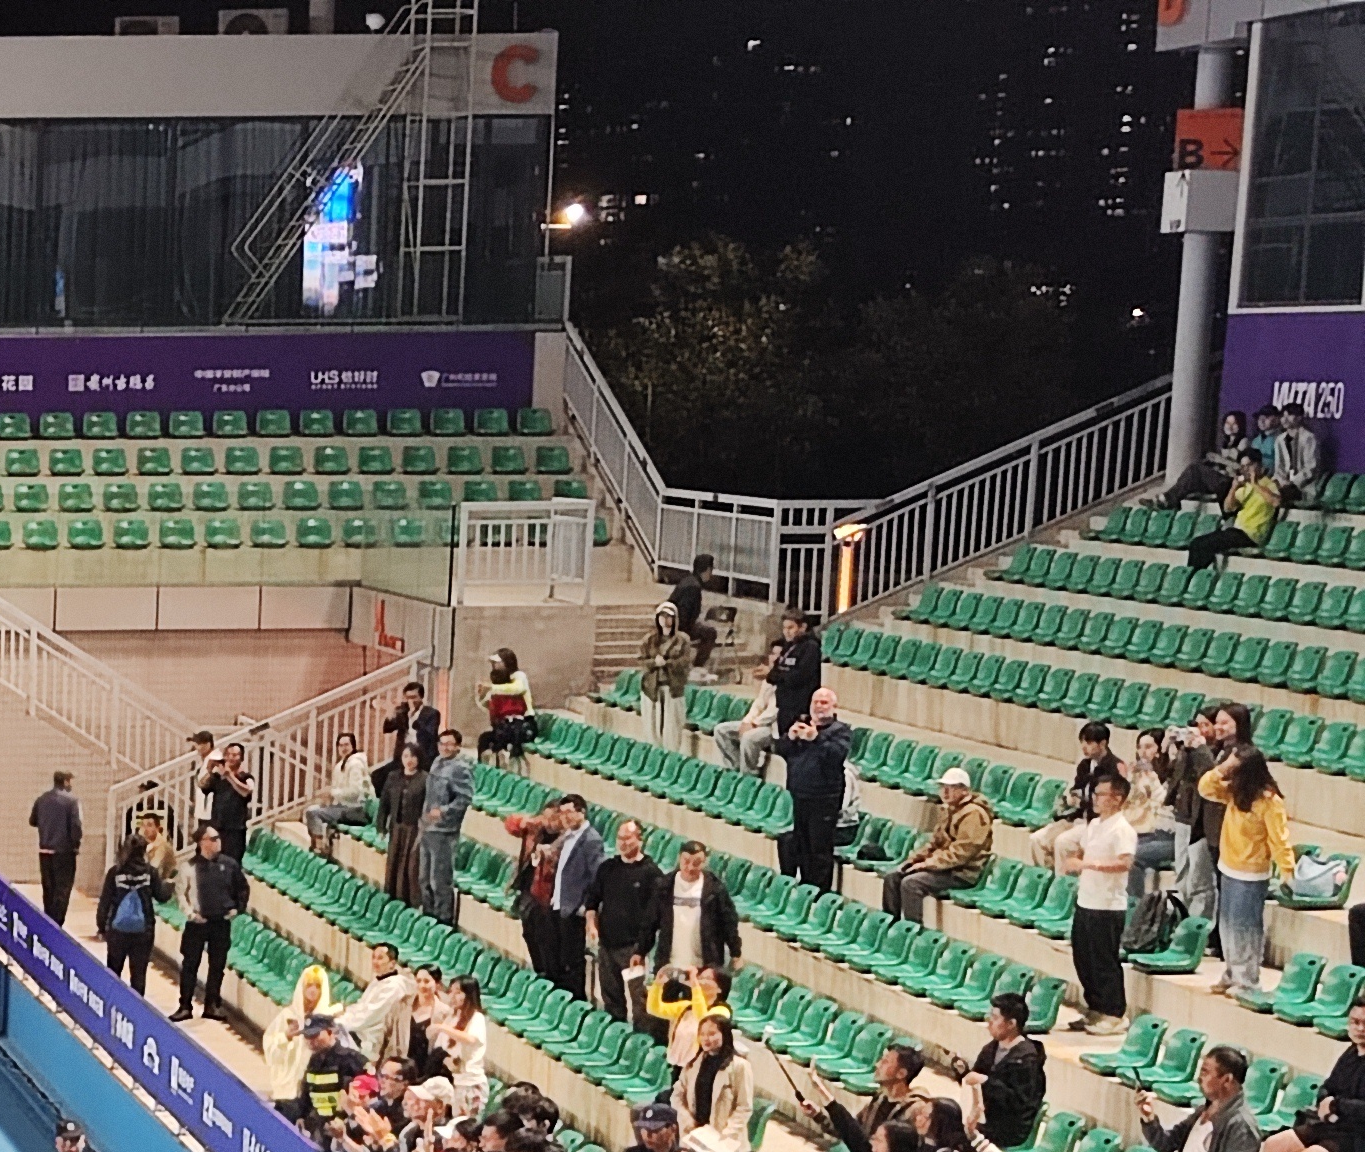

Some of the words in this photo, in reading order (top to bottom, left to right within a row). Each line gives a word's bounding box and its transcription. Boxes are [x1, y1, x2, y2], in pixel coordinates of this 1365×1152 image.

[491, 46, 538, 102] C
[1178, 139, 1204, 169] B
[1272, 381, 1317, 418] WTA
[1317, 381, 1345, 419] 250
